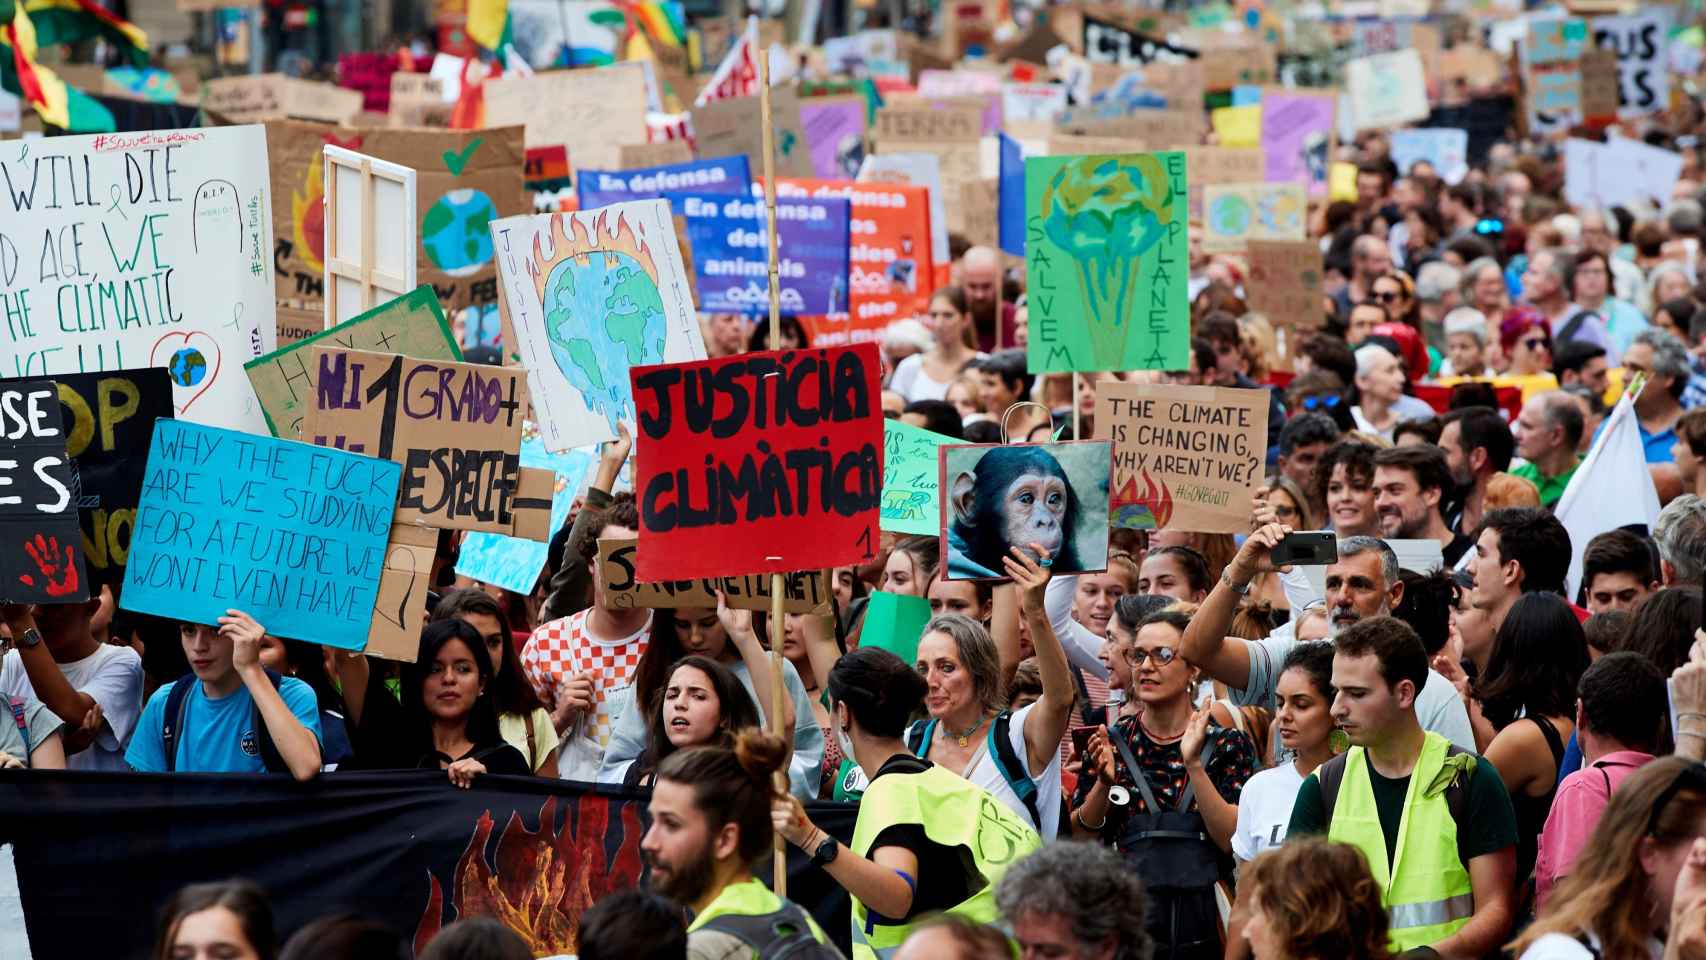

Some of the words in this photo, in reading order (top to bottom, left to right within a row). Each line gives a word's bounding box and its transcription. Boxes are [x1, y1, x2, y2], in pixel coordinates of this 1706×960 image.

[1, 154, 100, 212] WILL
[125, 144, 182, 204] DIE
[599, 174, 627, 192] En
[629, 167, 726, 193] defensa
[684, 197, 718, 217] En
[724, 199, 827, 221] defnsa
[40, 222, 97, 283] AGE,
[102, 213, 170, 272] WE
[704, 256, 806, 278] animls
[58, 268, 182, 332] CLIMATIC
[1027, 215, 1074, 369] SALVEM
[0, 391, 59, 440] SE
[403, 364, 500, 424] GRADO
[1108, 398, 1155, 418] THE
[1169, 402, 1252, 427] CLIMATE
[159, 428, 223, 465] WHY
[234, 440, 297, 481] THE
[307, 454, 391, 497] FUCK
[1111, 424, 1127, 442] IS
[1138, 425, 1252, 458] CHANGING,
[142, 469, 201, 505] ARE
[218, 476, 268, 512] WE
[1153, 454, 1214, 479] AREN'T
[1219, 457, 1260, 487] WE?
[136, 505, 196, 549] FOR
[231, 521, 336, 575] FUTURE
[344, 544, 386, 581] WE
[855, 527, 875, 559] 1
[132, 552, 208, 593] WONT
[212, 563, 288, 609] EVEN
[296, 579, 369, 623] HAVE
